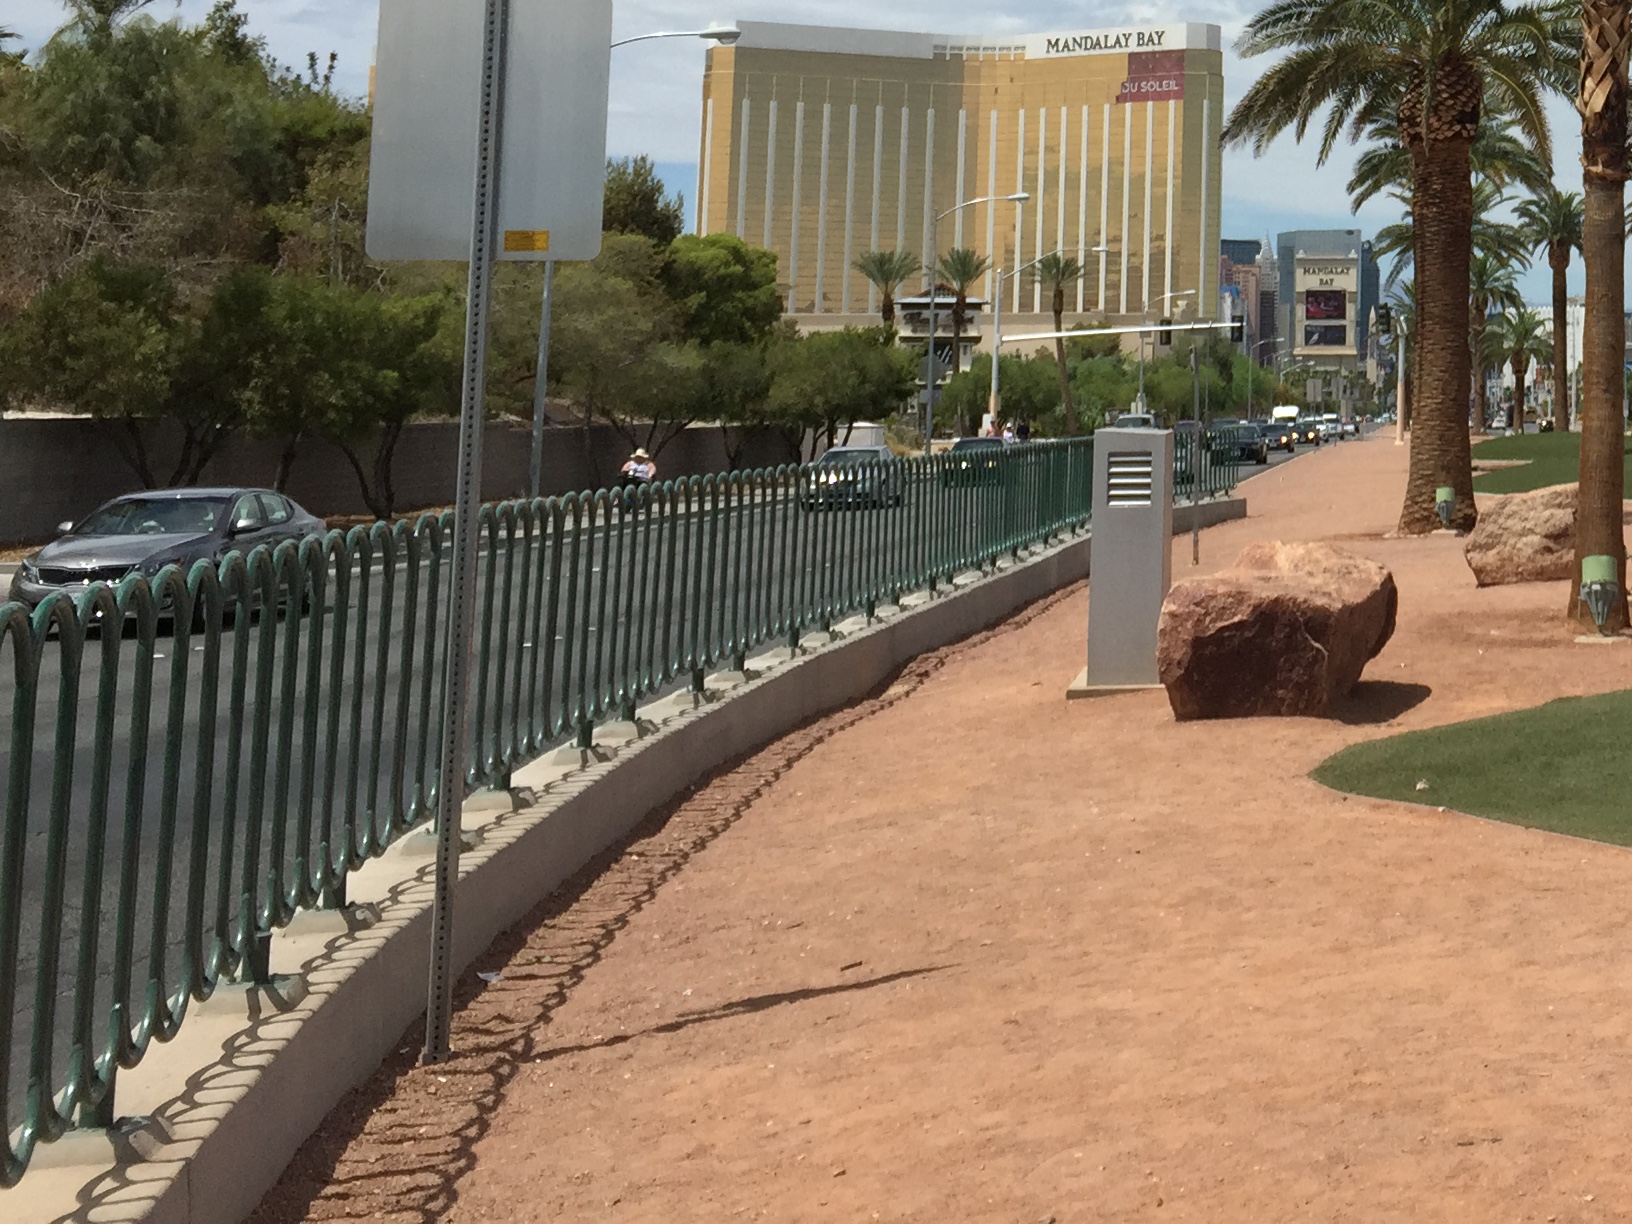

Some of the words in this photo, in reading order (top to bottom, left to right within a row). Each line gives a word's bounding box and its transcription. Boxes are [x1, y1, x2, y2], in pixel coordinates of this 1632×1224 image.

[1046, 32, 1133, 53] MANDALAY
[1136, 30, 1165, 47] BAY
[1140, 79, 1178, 92] SOLEIL
